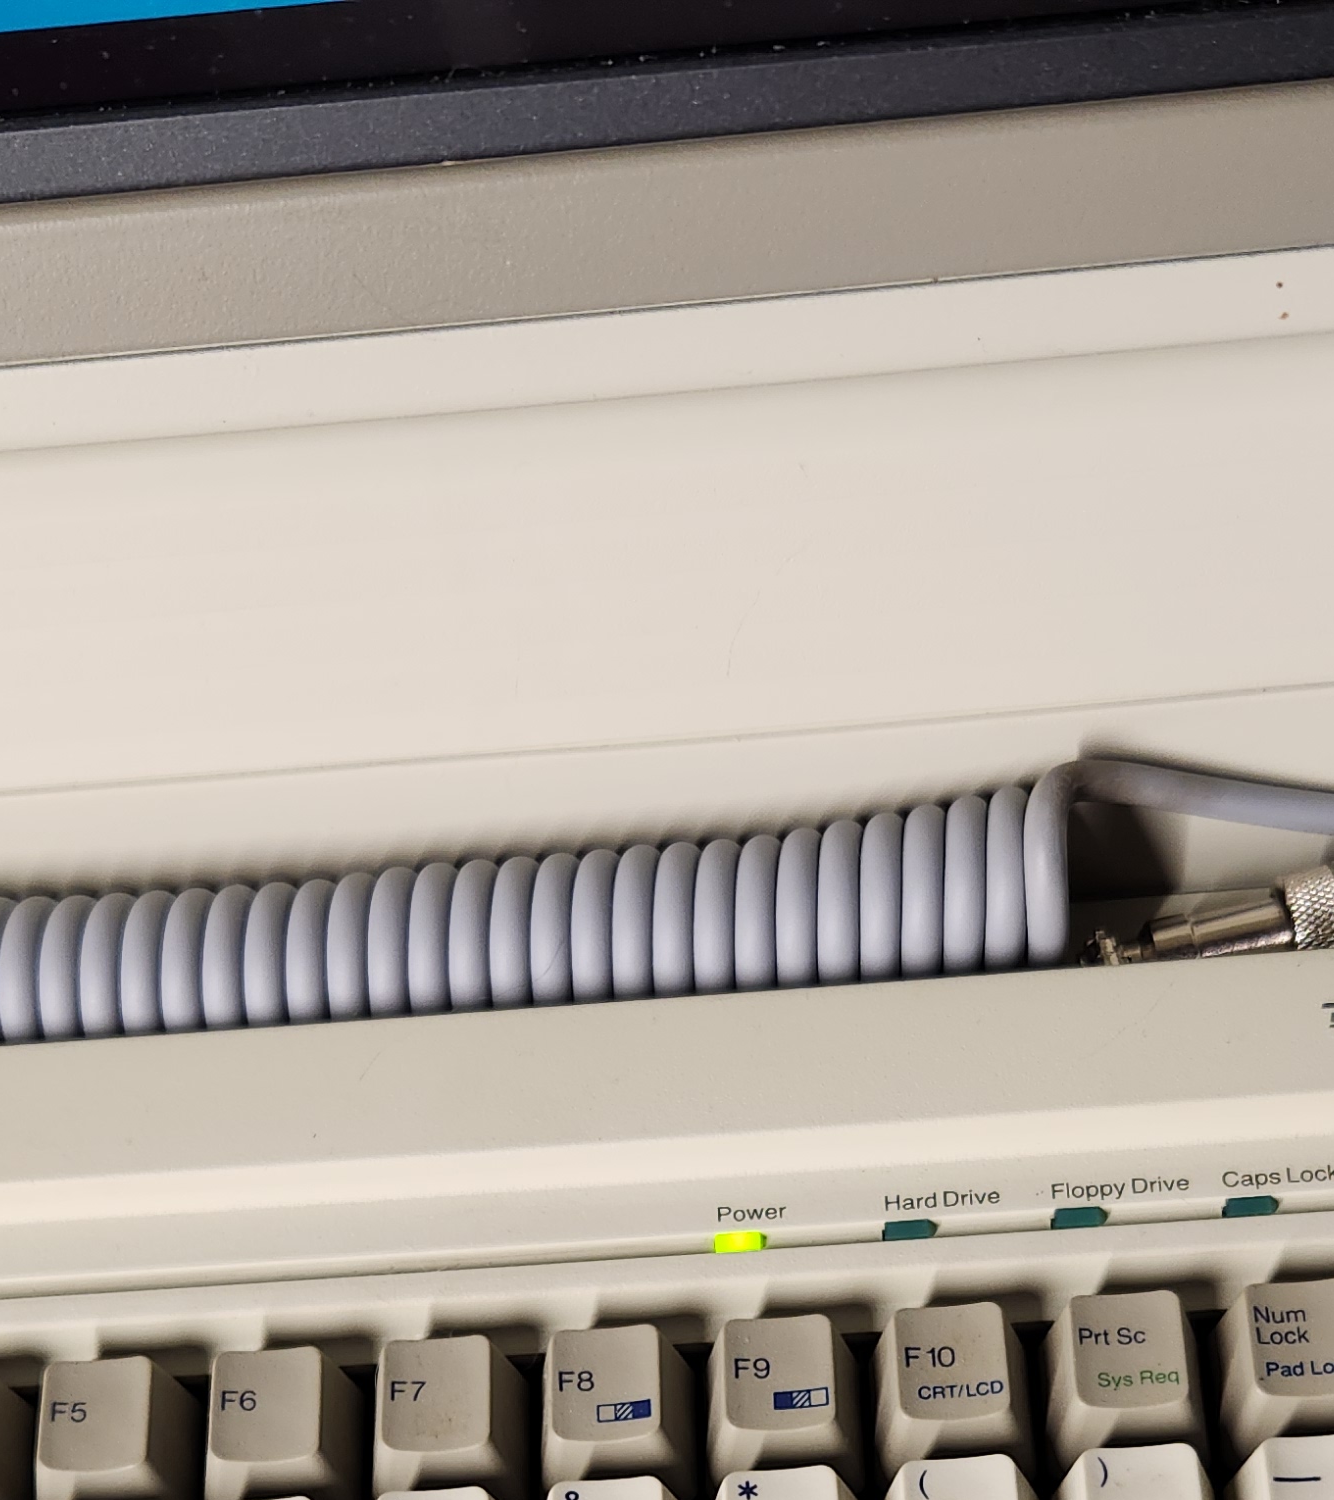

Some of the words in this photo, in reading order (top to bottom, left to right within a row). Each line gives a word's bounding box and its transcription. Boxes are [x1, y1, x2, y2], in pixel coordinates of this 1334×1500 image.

[1051, 1180, 1126, 1202] Floppy
[1131, 1175, 1190, 1194] Drive
[1222, 1169, 1281, 1190] Caps
[884, 1193, 938, 1211] Hard
[943, 1189, 1000, 1207] Drive
[717, 1205, 787, 1223] Power
[1253, 1306, 1307, 1325] Num
[1078, 1327, 1110, 1345] Prt
[1116, 1327, 1146, 1345] Sc
[1256, 1326, 1309, 1345] Lock
[904, 1347, 955, 1368] F10
[734, 1359, 770, 1379] F9
[1097, 1370, 1134, 1390] Sys
[1140, 1367, 1180, 1387] Req
[1266, 1360, 1306, 1378] Pad
[390, 1380, 427, 1402] F7
[558, 1371, 594, 1392] F8
[917, 1380, 1004, 1401] CRT/LCD
[50, 1401, 87, 1422] F5
[220, 1390, 257, 1412] F6
